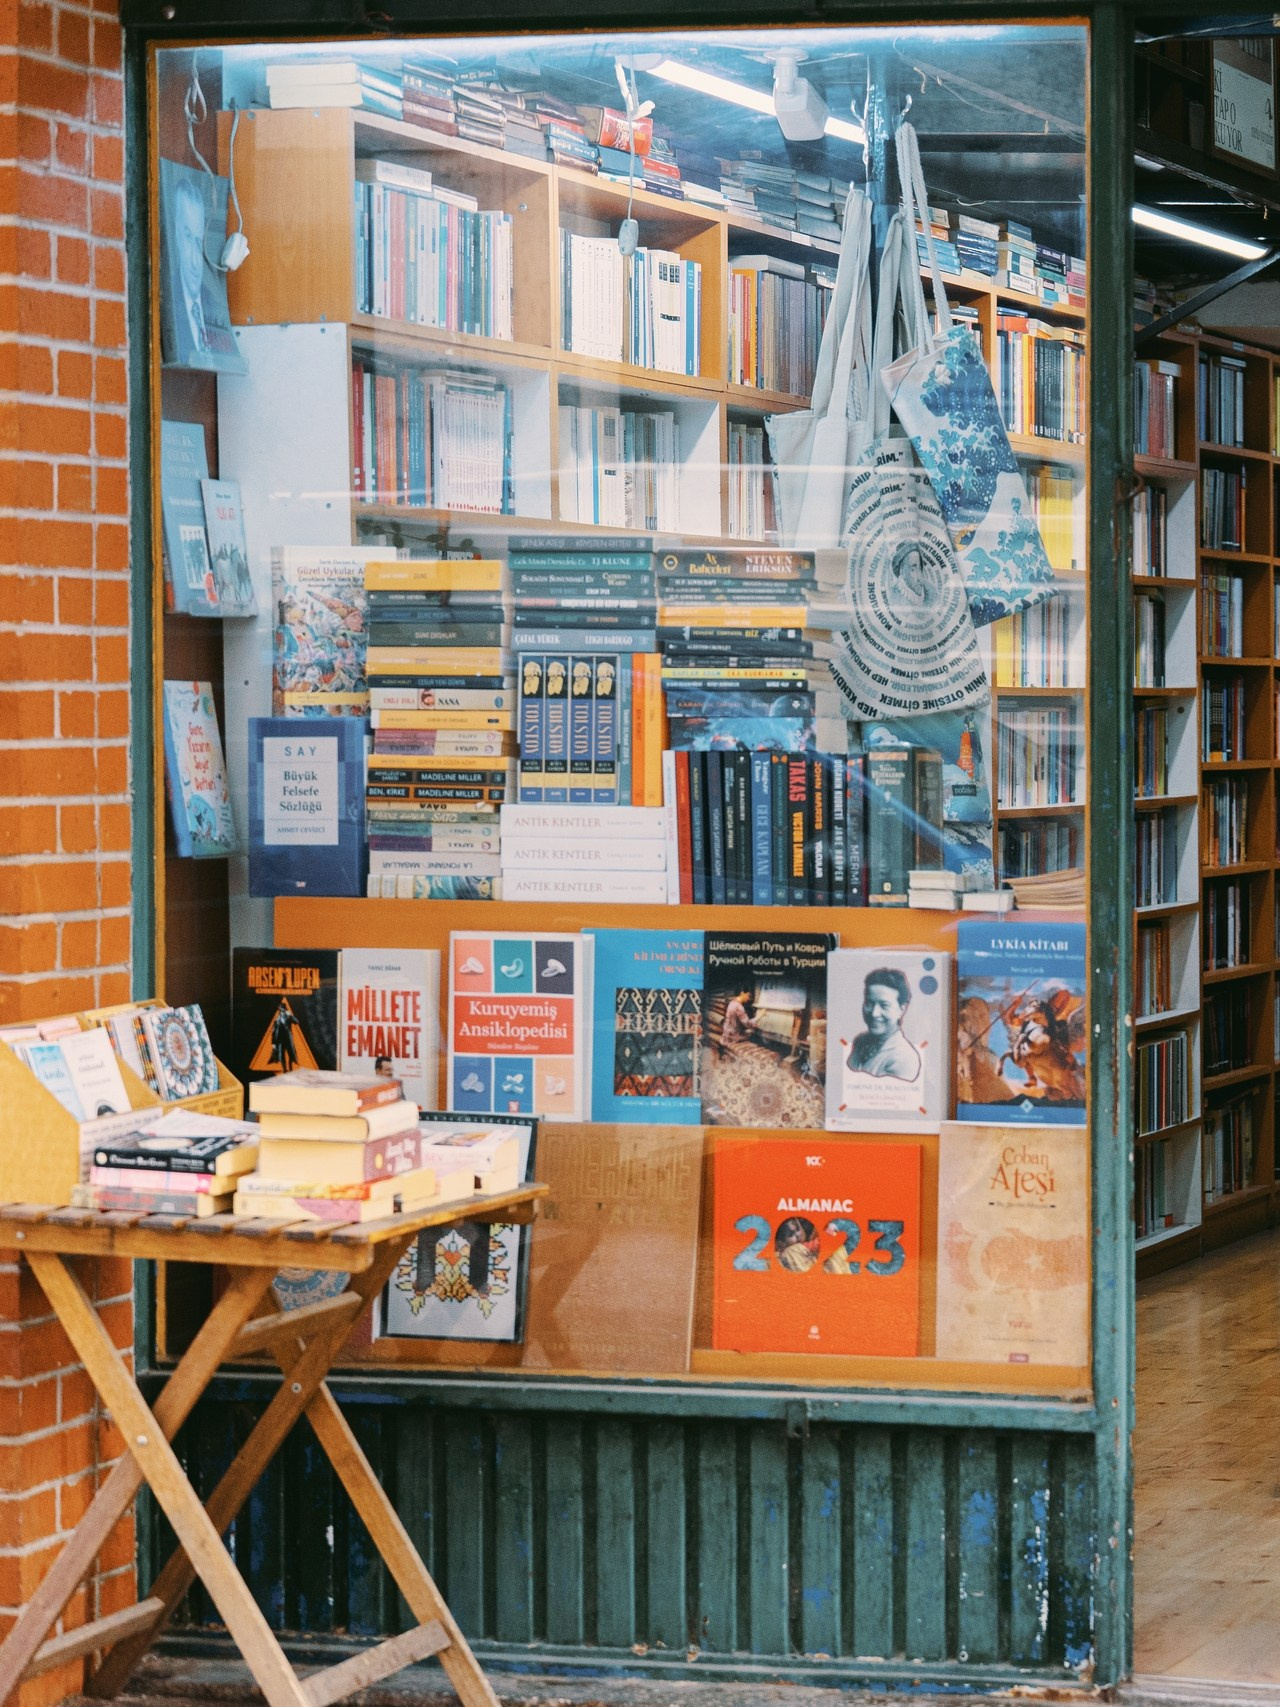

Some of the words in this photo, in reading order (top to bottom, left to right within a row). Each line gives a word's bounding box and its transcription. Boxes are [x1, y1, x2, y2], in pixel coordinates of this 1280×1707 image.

[1214, 67, 1222, 93] Kİ
[1214, 95, 1228, 121] TAP
[1230, 102, 1237, 125] O
[1214, 121, 1226, 145] KU
[1227, 125, 1243, 153] YOR
[591, 557, 600, 566] TJ
[602, 557, 630, 566] KLUNE
[746, 555, 792, 564] STEVEN
[746, 564, 793, 573] ERIKSON
[297, 566, 321, 577] Güzel
[322, 567, 356, 578] Uykular
[867, 582, 893, 632] MONTAIGNE
[515, 635, 535, 646] ÇATAL
[535, 633, 561, 645] YÜREK
[871, 673, 889, 687] HEP
[890, 666, 920, 681] GİTMEK
[921, 664, 948, 677] ÖTESİNE
[438, 698, 460, 706] NANA
[857, 701, 878, 718] HEP
[879, 693, 920, 712] GİTMEK
[922, 689, 964, 710] ÖTESİNE
[525, 703, 539, 755] TOLSTOY
[549, 703, 563, 755] TOLSTOY
[575, 703, 589, 755] TOLSTOY
[598, 703, 612, 755] TOLSTOY
[285, 746, 317, 757] SAY
[284, 770, 318, 783] Büyük
[421, 772, 458, 782] MADELINE
[459, 773, 482, 782] MILLER
[754, 760, 763, 783] Choo
[789, 760, 807, 803] TAKAS
[814, 762, 823, 789] JOHN
[282, 784, 319, 796] Felsefe
[385, 787, 406, 797] KİRKE
[418, 789, 455, 798] MADELINE
[456, 789, 480, 799] MILLER
[279, 800, 322, 813] Sözlüğü
[814, 791, 823, 830] MARRS
[513, 815, 550, 827] ANTİK
[552, 817, 601, 828] KENTLER
[793, 811, 805, 842] VICTOR
[834, 825, 844, 846] JANE
[513, 848, 550, 860] ANTİK
[552, 850, 601, 861] KENTLER
[793, 843, 805, 878] LAVALLE
[815, 840, 824, 879] YOLCULAR
[834, 849, 844, 882] HARPER
[515, 880, 552, 892] ANTİK
[553, 882, 603, 893] KENTLER
[709, 940, 761, 951] Шёлковый
[762, 942, 785, 953] Путь
[794, 943, 826, 954] Ковры
[991, 938, 1027, 950] LYKİA
[1029, 938, 1069, 951] KİTABI
[709, 955, 745, 967] Ручной
[747, 956, 782, 967] Работы
[783, 958, 790, 966] в
[791, 957, 827, 968] Турции
[248, 966, 283, 989] ARSEN
[347, 986, 422, 1023] MİLLETE
[469, 1000, 558, 1021] Kuruyemiş
[459, 1021, 568, 1041] Ansiklopedisi
[347, 1024, 421, 1059] EMANET
[1001, 1146, 1050, 1167] Çoban
[990, 1164, 1057, 1199] Ateşi
[776, 1198, 854, 1213] ALMANAC
[732, 1214, 906, 1276] 2023
